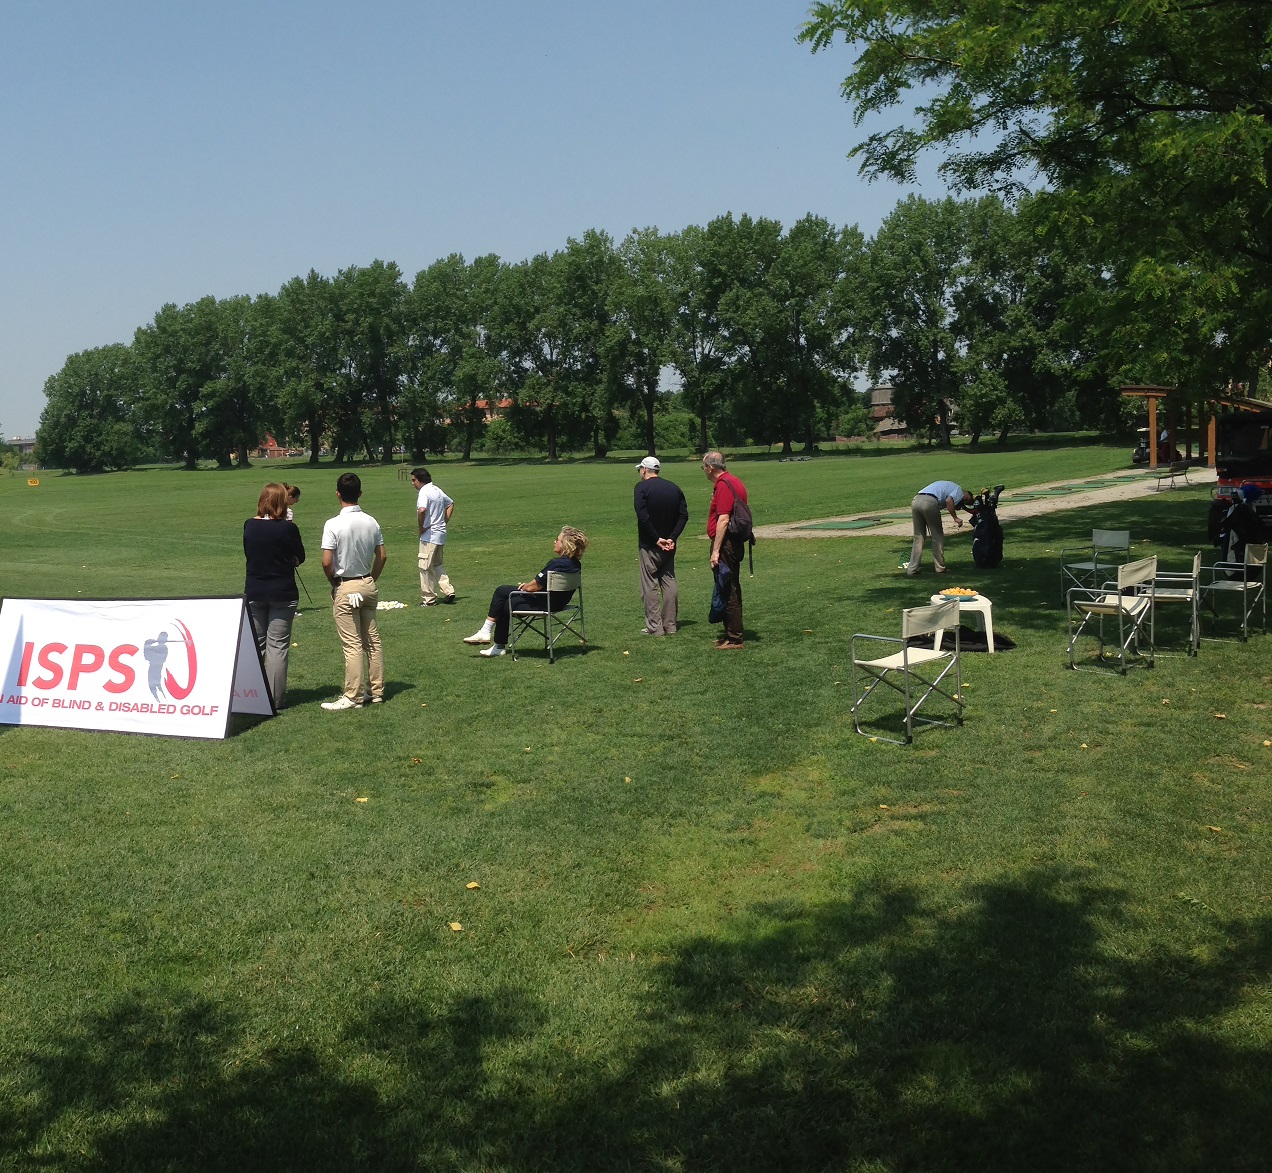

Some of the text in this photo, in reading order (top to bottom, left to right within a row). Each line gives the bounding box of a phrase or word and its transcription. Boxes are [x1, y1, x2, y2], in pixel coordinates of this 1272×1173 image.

[17, 641, 140, 694] ISPS
[6, 694, 29, 705] AID
[31, 697, 50, 707] OF
[52, 698, 92, 710] BLIND
[94, 701, 105, 711] &
[108, 701, 177, 715] DISABLED
[179, 704, 219, 716] GOLF
